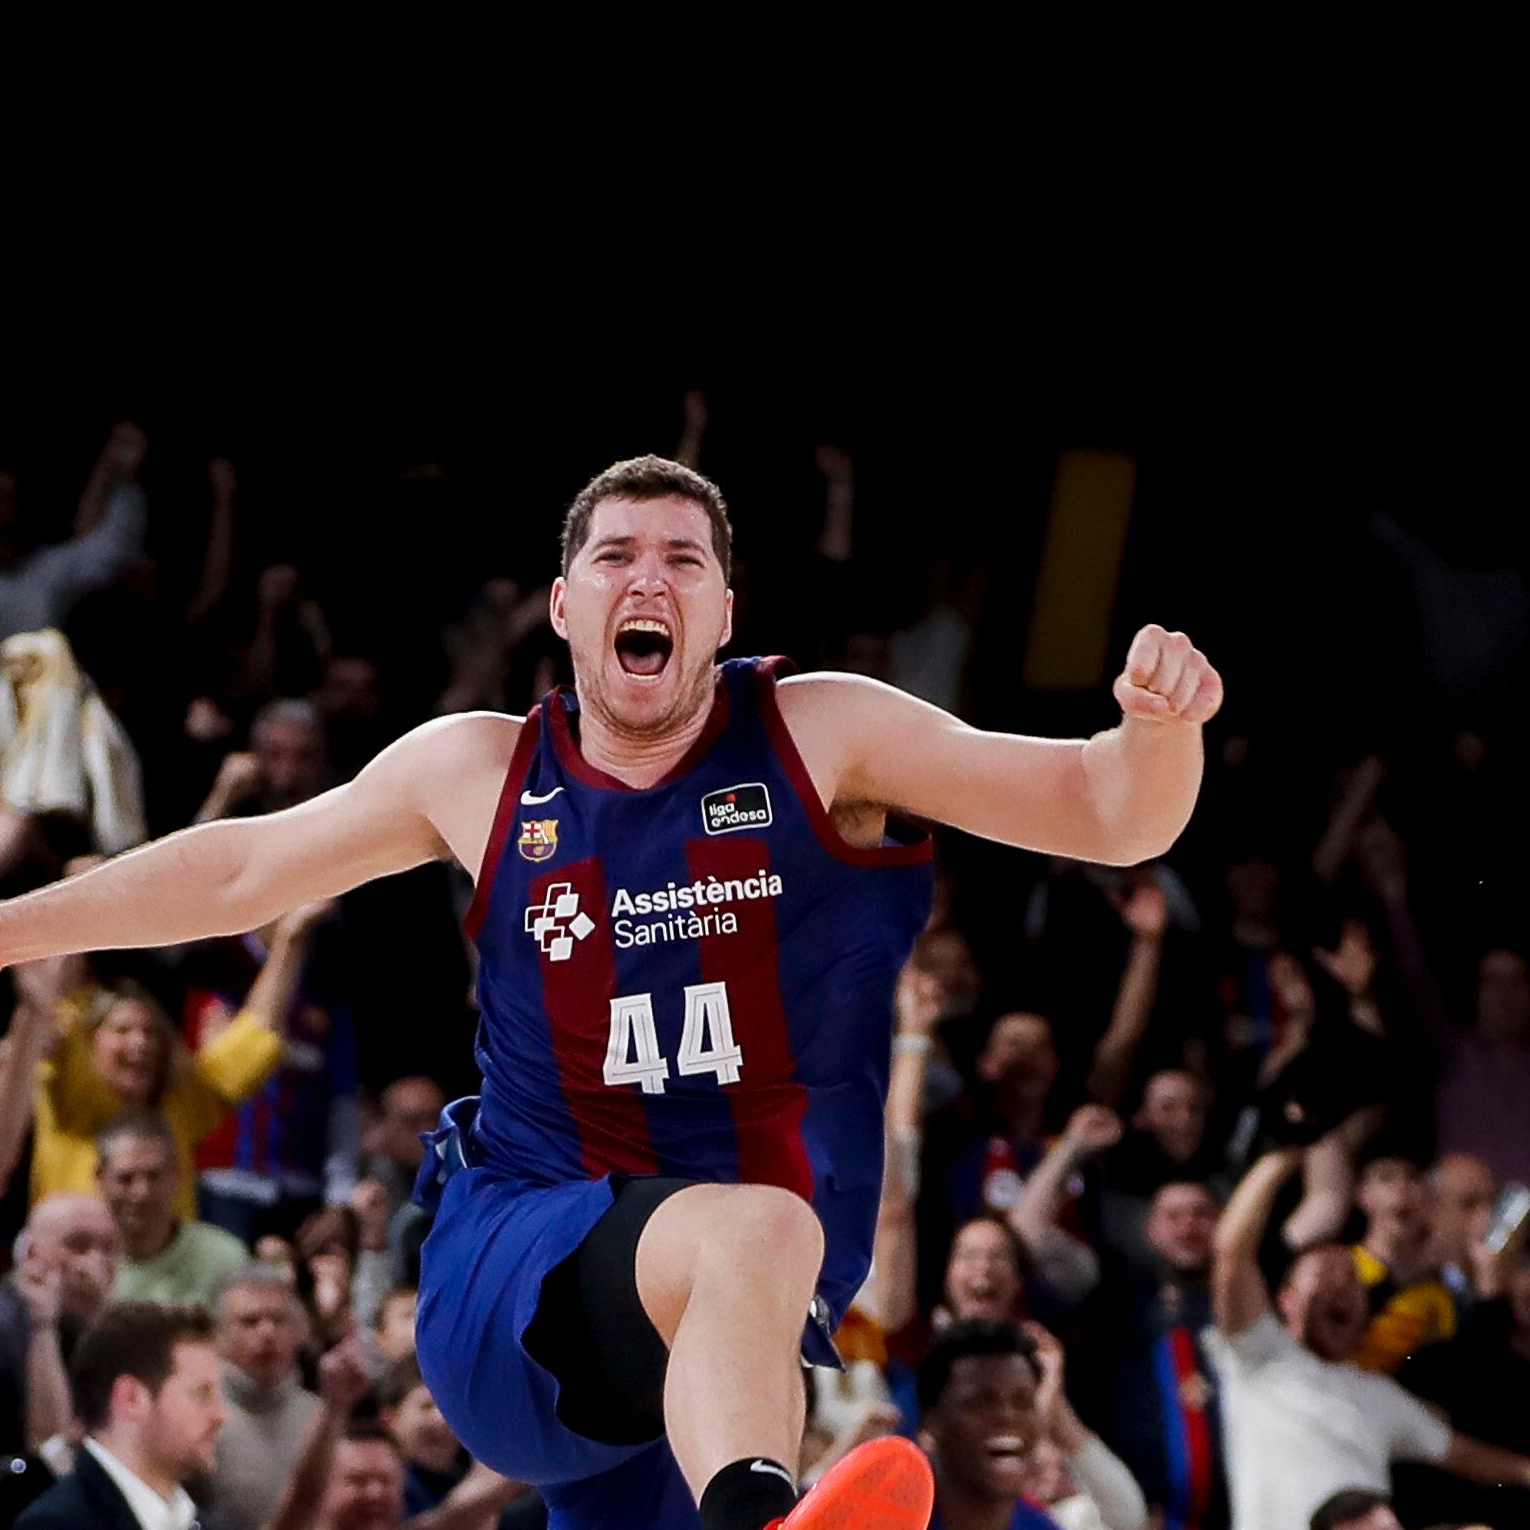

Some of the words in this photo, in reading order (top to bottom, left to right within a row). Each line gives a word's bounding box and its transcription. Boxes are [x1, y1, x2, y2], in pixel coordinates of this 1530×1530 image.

[709, 803, 735, 816] liga
[711, 809, 767, 827] endosa
[611, 869, 783, 917] Assistència
[614, 907, 738, 948] Sanitària
[602, 981, 744, 1094] 44
